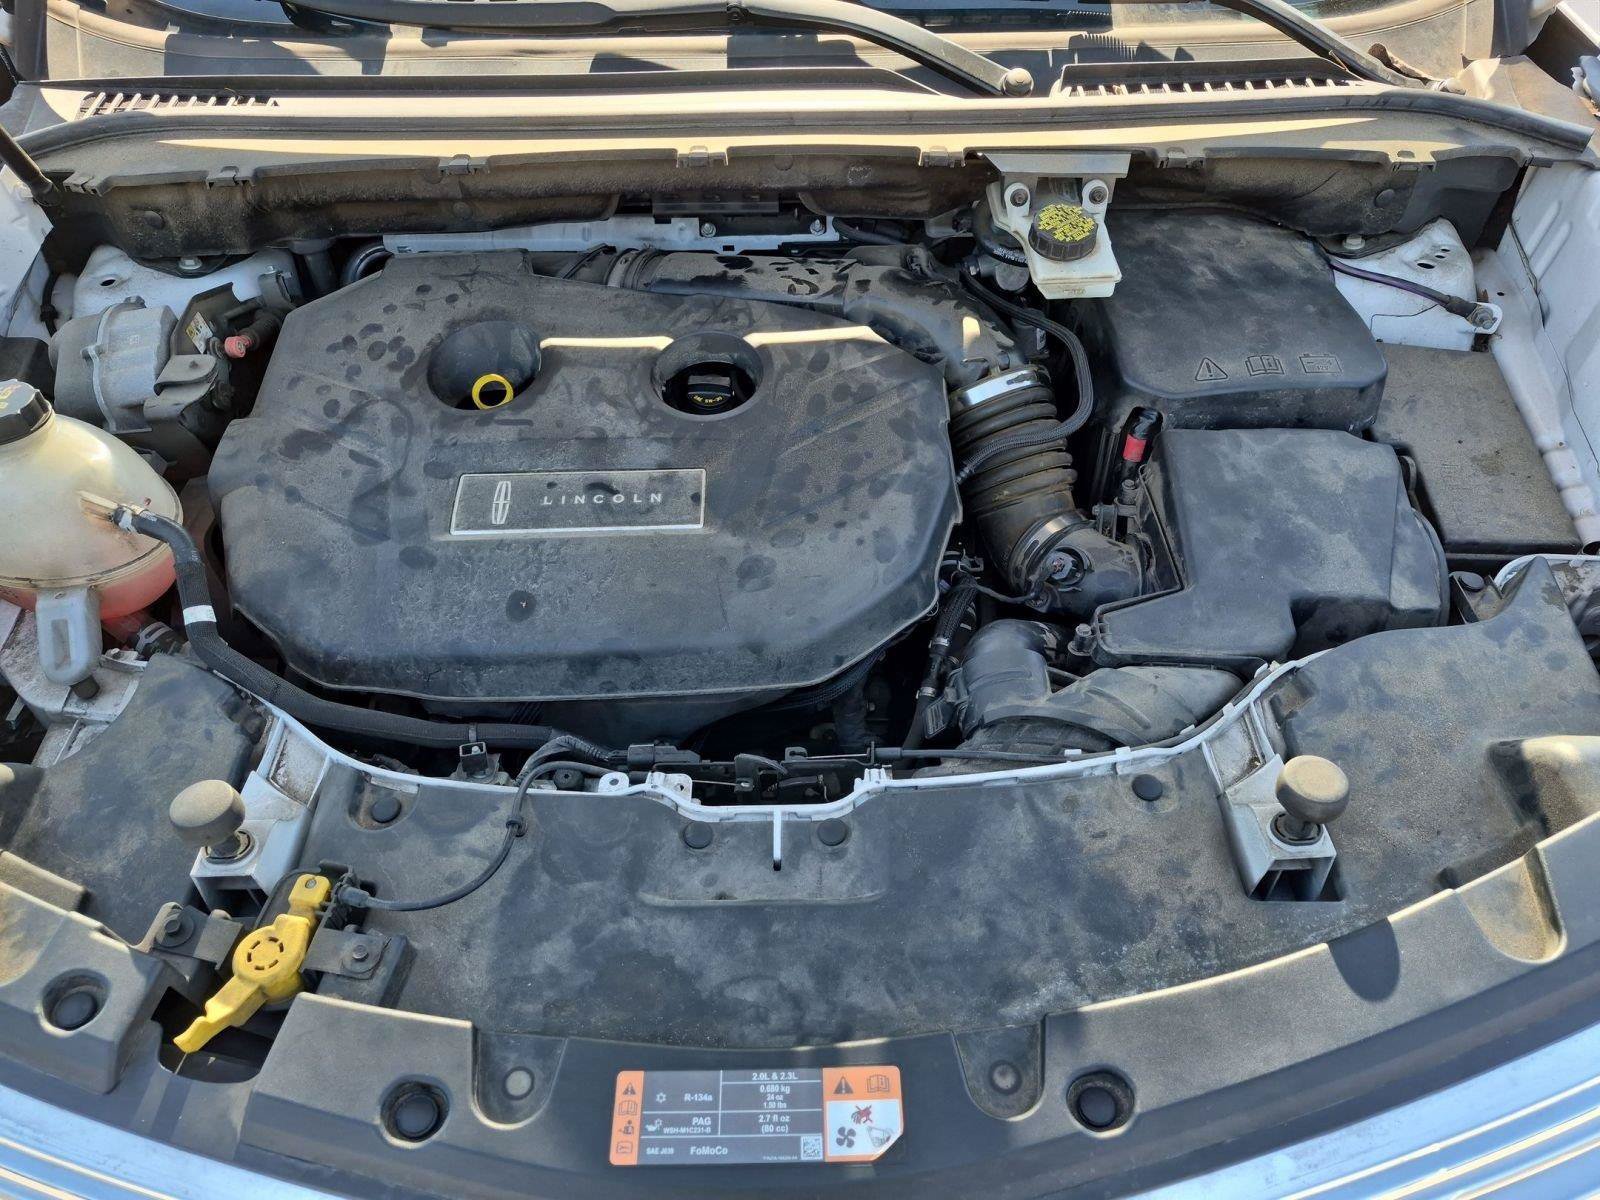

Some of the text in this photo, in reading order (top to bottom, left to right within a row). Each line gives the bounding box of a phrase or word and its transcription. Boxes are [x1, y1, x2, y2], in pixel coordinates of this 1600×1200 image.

[543, 493, 663, 505] LINCOLN
[752, 1071, 799, 1081] 2.0L & 2.3L
[780, 1084, 790, 1095] kg
[684, 1093, 713, 1102] R-134a
[777, 1101, 787, 1109] lbs
[692, 1116, 711, 1126] PAG
[758, 1114, 771, 1123] 2.7
[776, 1124, 789, 1133] cc)
[690, 1145, 728, 1156] FoMoCo
